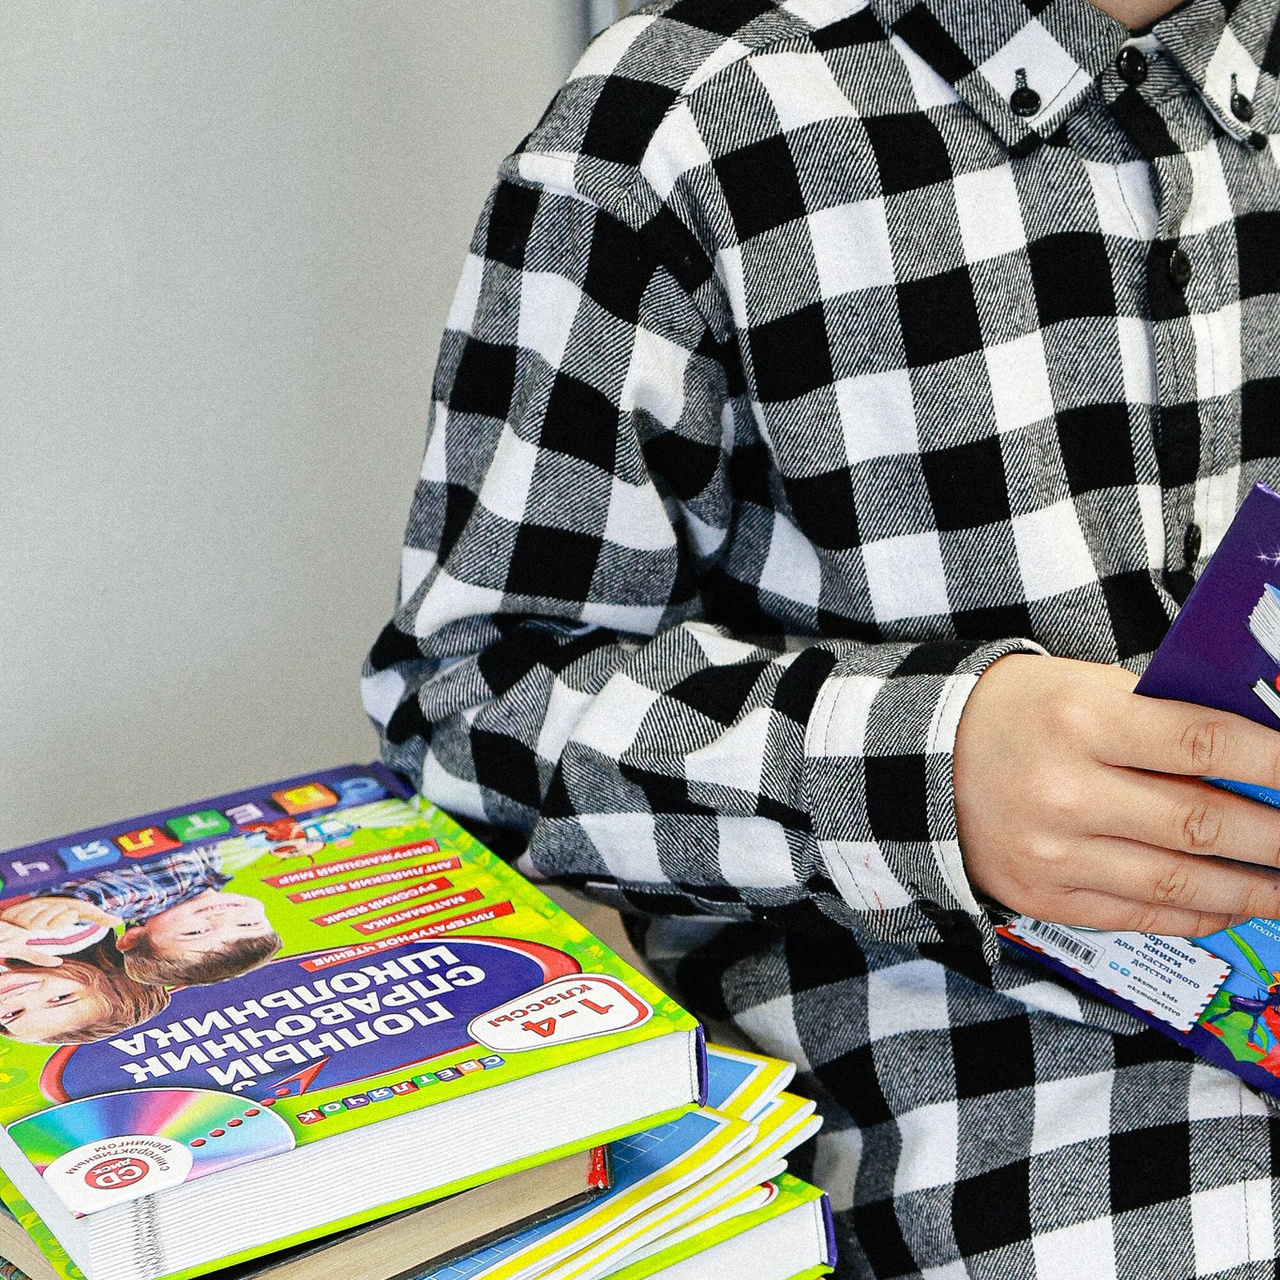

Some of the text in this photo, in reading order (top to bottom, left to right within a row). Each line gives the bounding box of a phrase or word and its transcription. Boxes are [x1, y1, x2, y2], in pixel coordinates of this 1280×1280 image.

[277, 843, 434, 885] ОКРУЖАЮЩИЙ МИР
[299, 858, 452, 902] АНГЛИЙСКИЙ ЯЗЫК
[321, 881, 437, 925] РУССКИЙ ЯЗЫК
[362, 893, 465, 930] МАТЕМАТИКА
[311, 908, 494, 968] ЛИТЕРАТУРНОЕ ЧТЕНИЕ
[1142, 942, 1182, 968] книги
[1113, 937, 1135, 953] для
[1134, 949, 1200, 990] счастливого
[1130, 957, 1173, 984] детства
[107, 944, 460, 1059] ШКОЛЬНИКА
[486, 984, 592, 1027] классы
[1126, 983, 1181, 1017] eksmodetstvo
[1131, 974, 1178, 1004] eksmo_kids
[118, 961, 486, 1083] СПРАВОЧНИК
[205, 1000, 454, 1092] ПОЛНЫЙ
[296, 1052, 504, 1124] СВЕТЛЯЧОК
[93, 1139, 171, 1152] тренингом
[93, 1163, 143, 1188] CD
